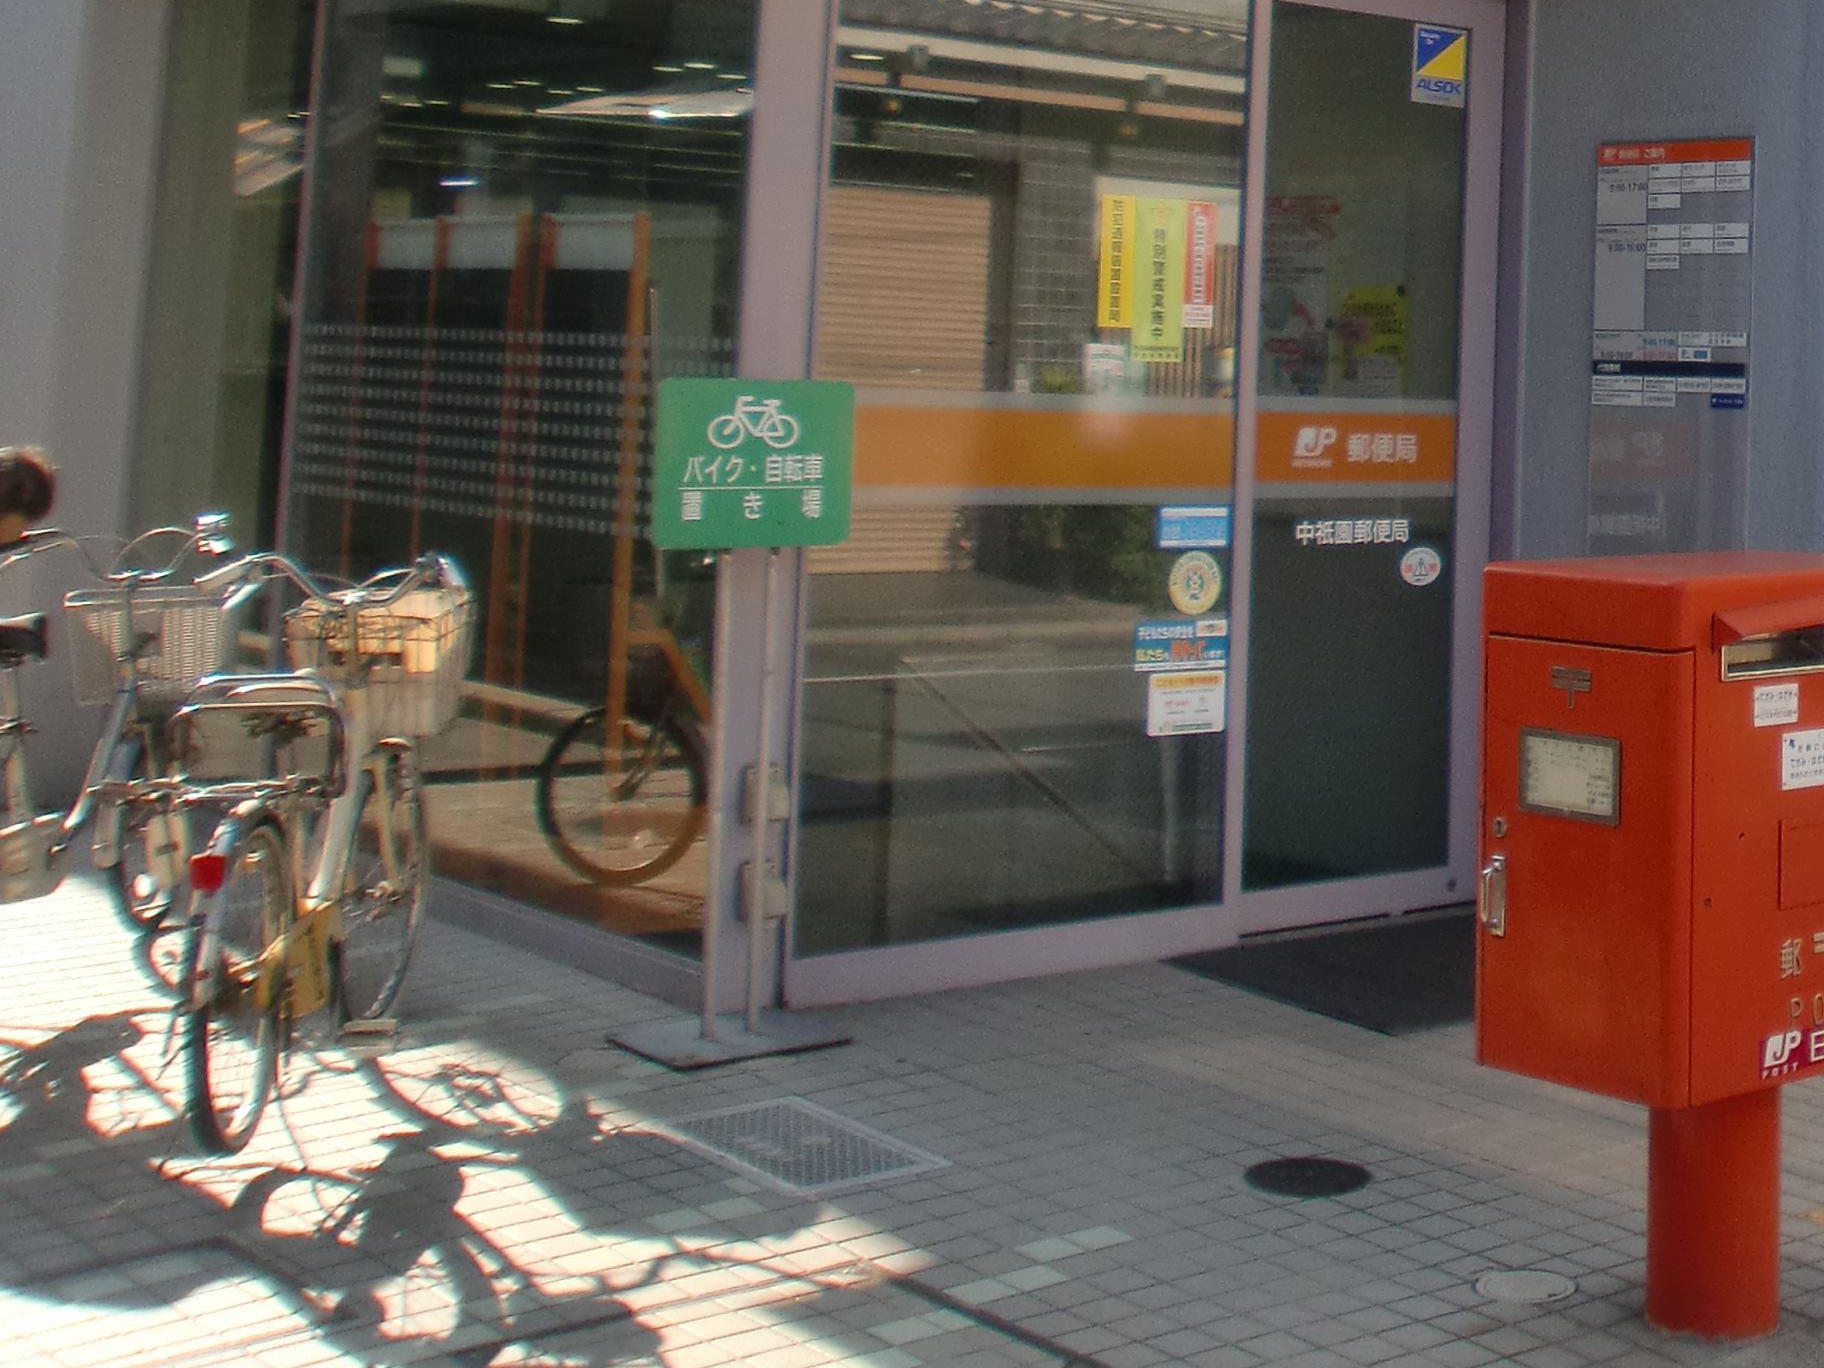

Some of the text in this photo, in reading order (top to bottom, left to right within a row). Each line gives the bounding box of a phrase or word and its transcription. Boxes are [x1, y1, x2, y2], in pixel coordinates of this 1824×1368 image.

[1416, 78, 1462, 95] ALSOK
[1347, 433, 1418, 463] 郵便局
[683, 454, 823, 483] バイク・自転車
[1294, 519, 1410, 546] 中祇園郵便局
[1761, 1062, 1799, 1080] POST
